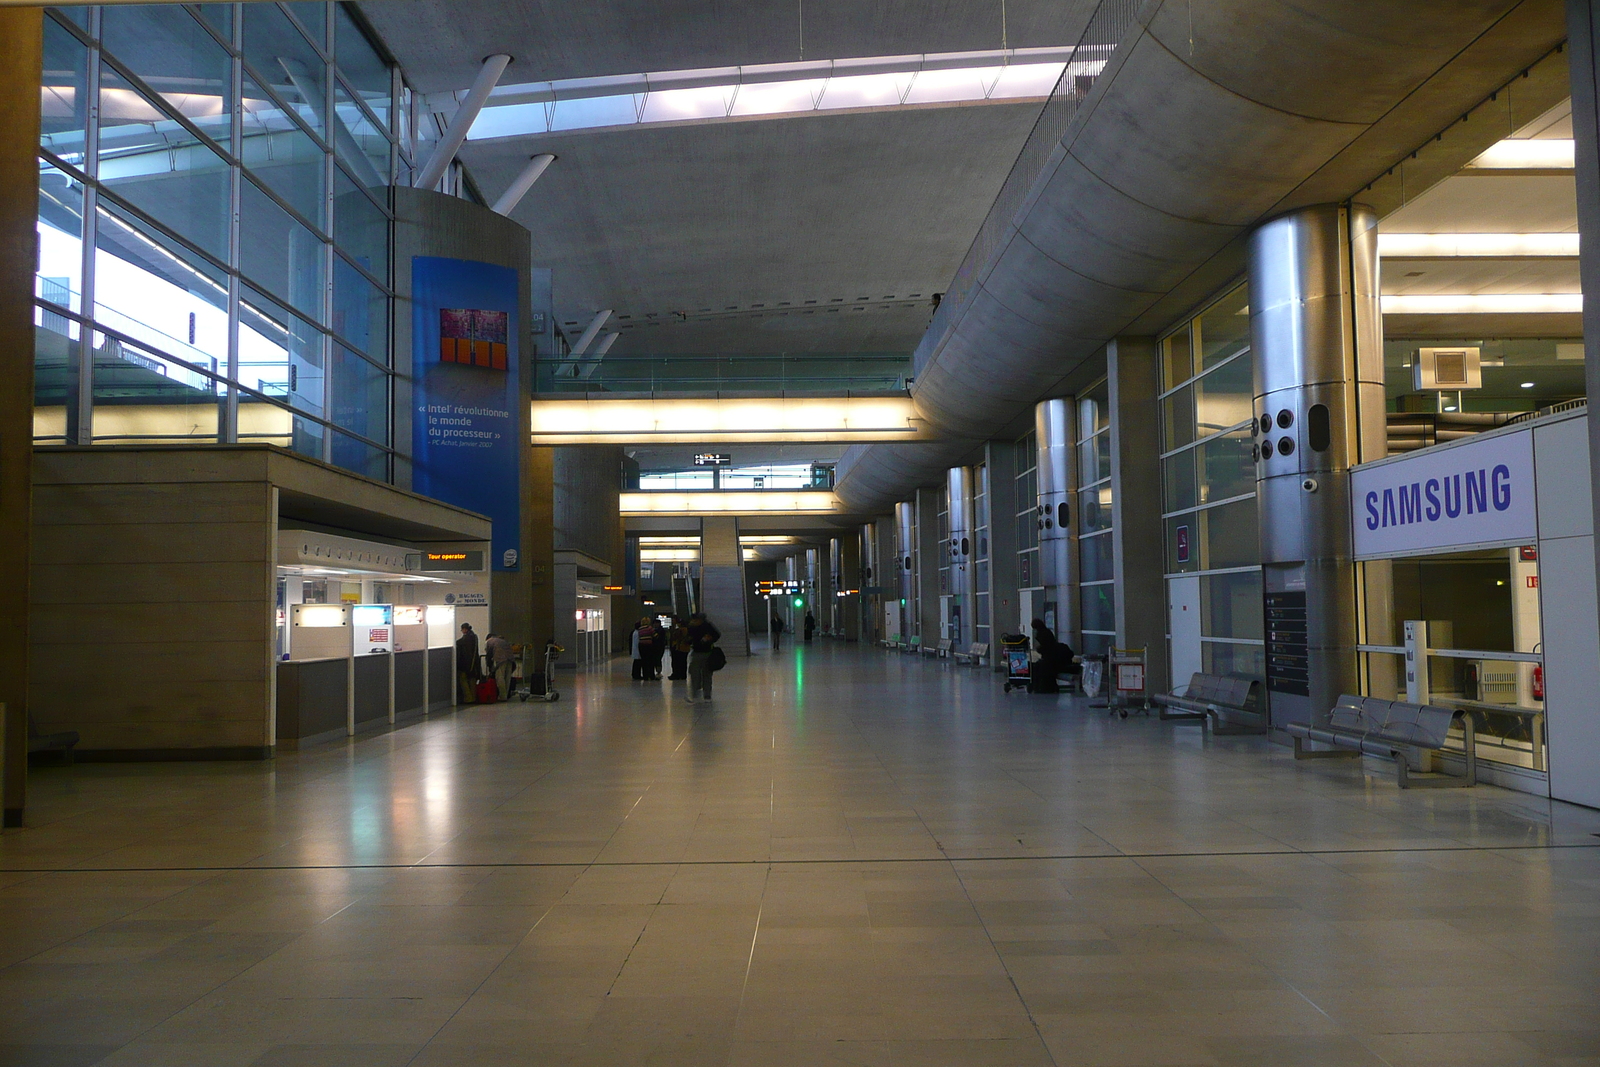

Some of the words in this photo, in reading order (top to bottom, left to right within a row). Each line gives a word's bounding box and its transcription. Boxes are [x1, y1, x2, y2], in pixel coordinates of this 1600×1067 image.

[454, 405, 509, 418] révolutionne
[428, 415, 438, 425] le
[439, 416, 472, 426] monde
[428, 427, 441, 436] du
[443, 428, 492, 439] processeur
[1365, 463, 1512, 531] SAMSUNG
[441, 553, 466, 561] operator
